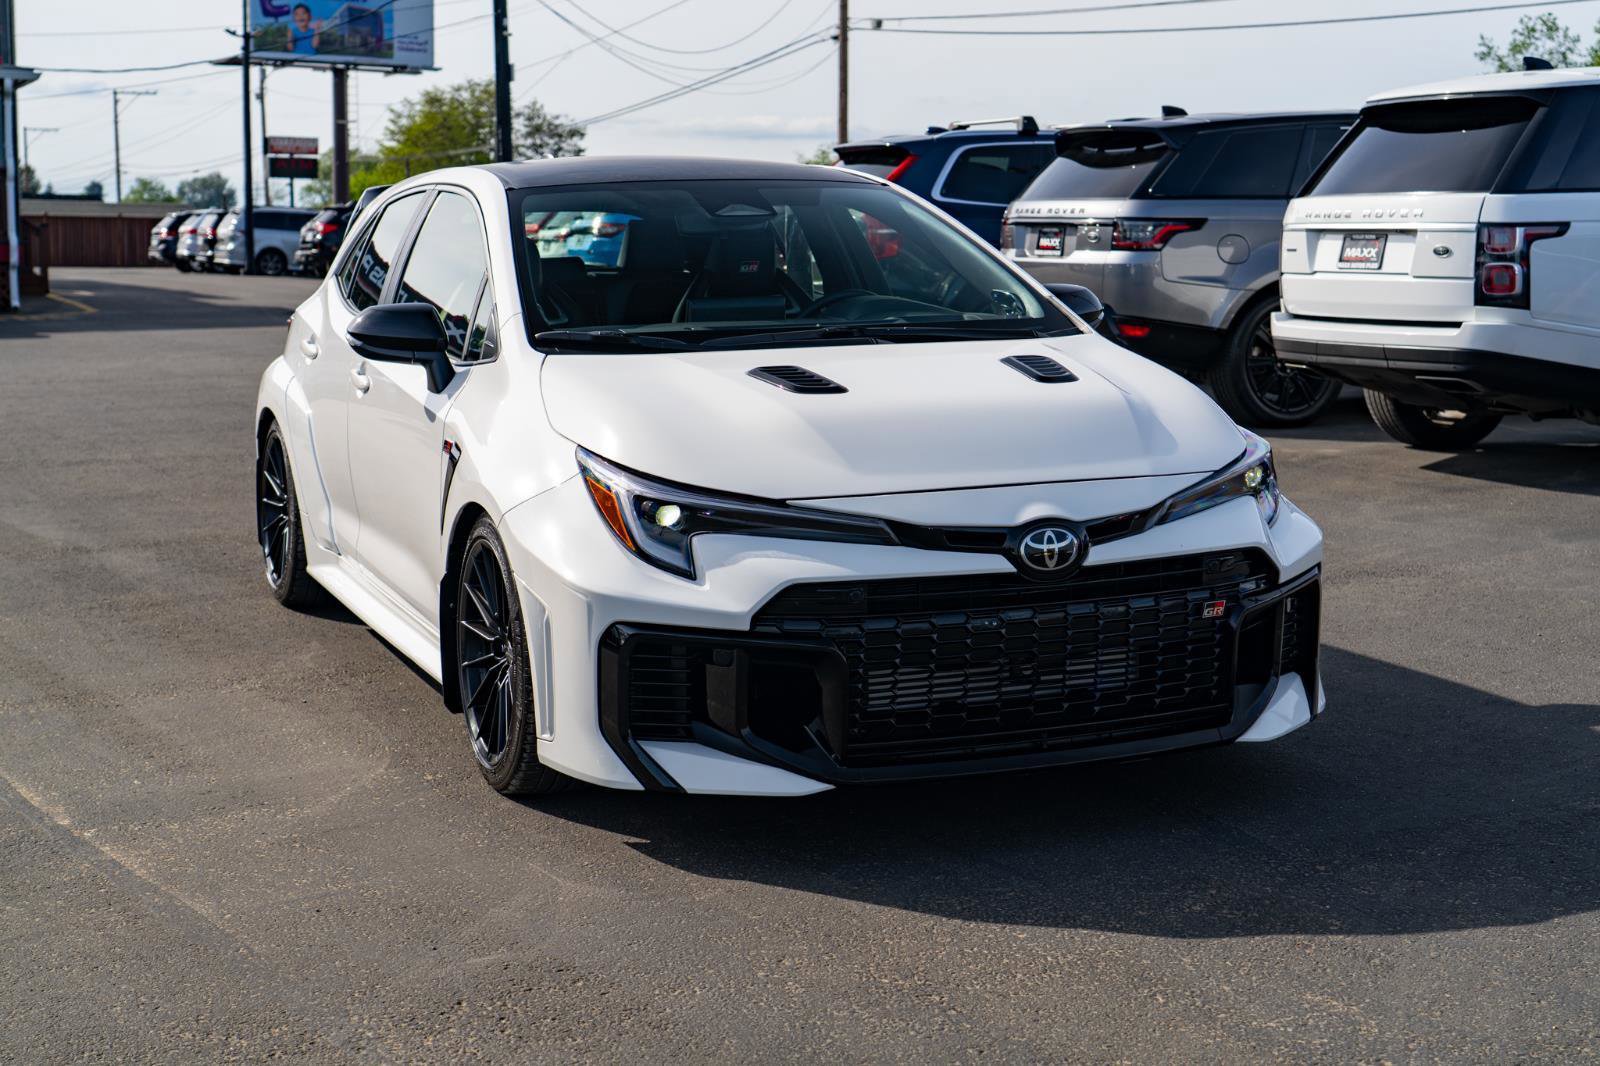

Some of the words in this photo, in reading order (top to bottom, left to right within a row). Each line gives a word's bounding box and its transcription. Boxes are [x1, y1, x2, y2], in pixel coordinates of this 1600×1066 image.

[1047, 207, 1087, 215] ROVER
[1362, 207, 1424, 219] ROVER
[1344, 247, 1378, 258] MAXX
